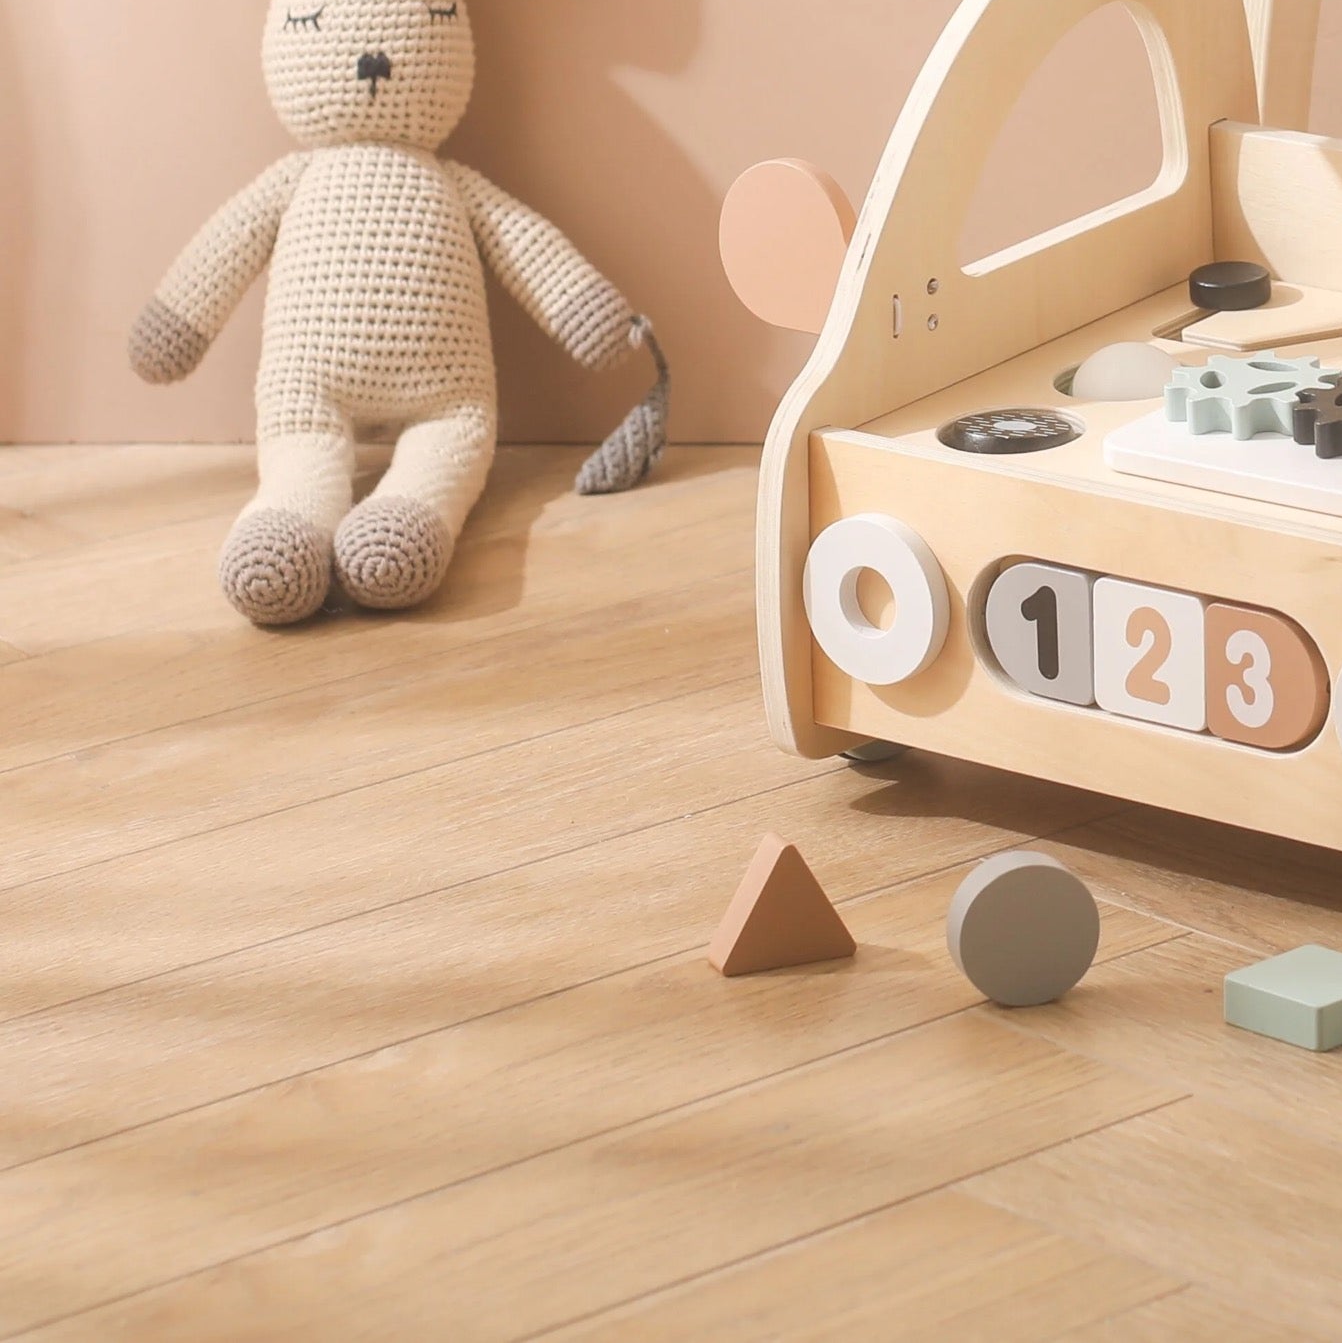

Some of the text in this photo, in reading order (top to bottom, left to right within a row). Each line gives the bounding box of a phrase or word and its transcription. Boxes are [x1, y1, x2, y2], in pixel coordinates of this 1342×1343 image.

[1020, 585, 1274, 729] 1 2 3
